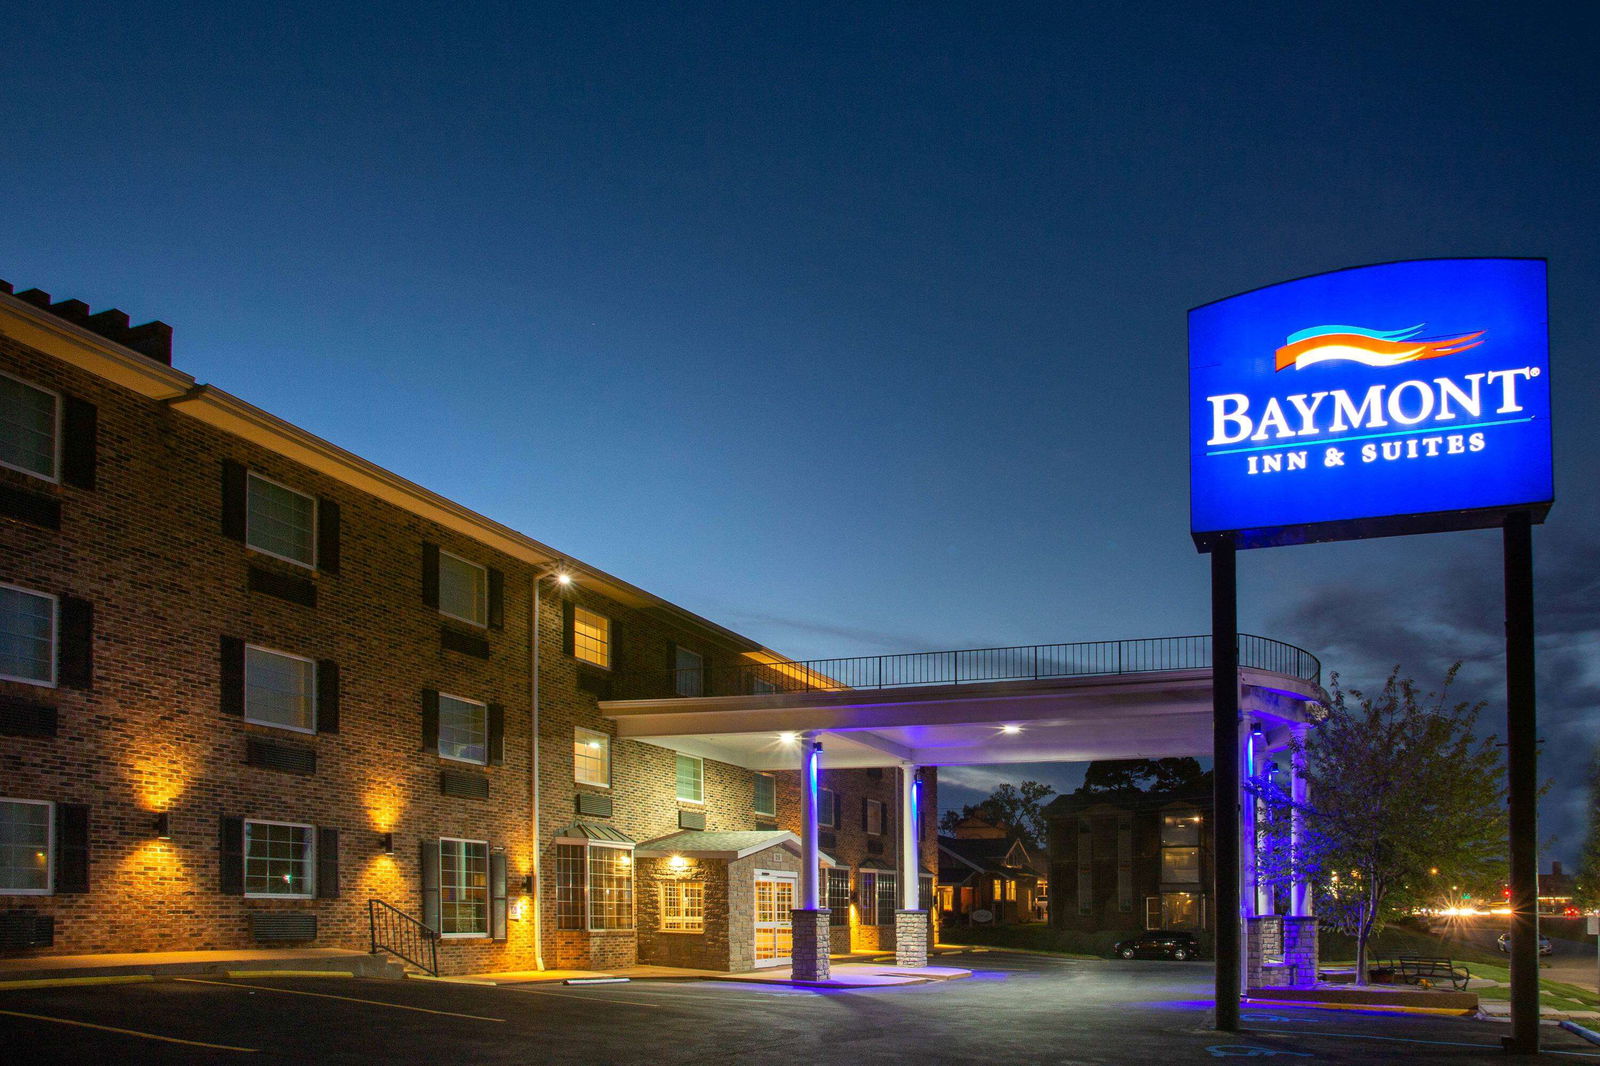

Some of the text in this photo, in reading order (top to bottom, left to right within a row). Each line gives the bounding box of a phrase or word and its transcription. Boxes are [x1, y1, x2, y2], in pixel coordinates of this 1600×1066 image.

[1206, 366, 1531, 446] BAYMONT
[1247, 432, 1486, 475] INN & SUITES
